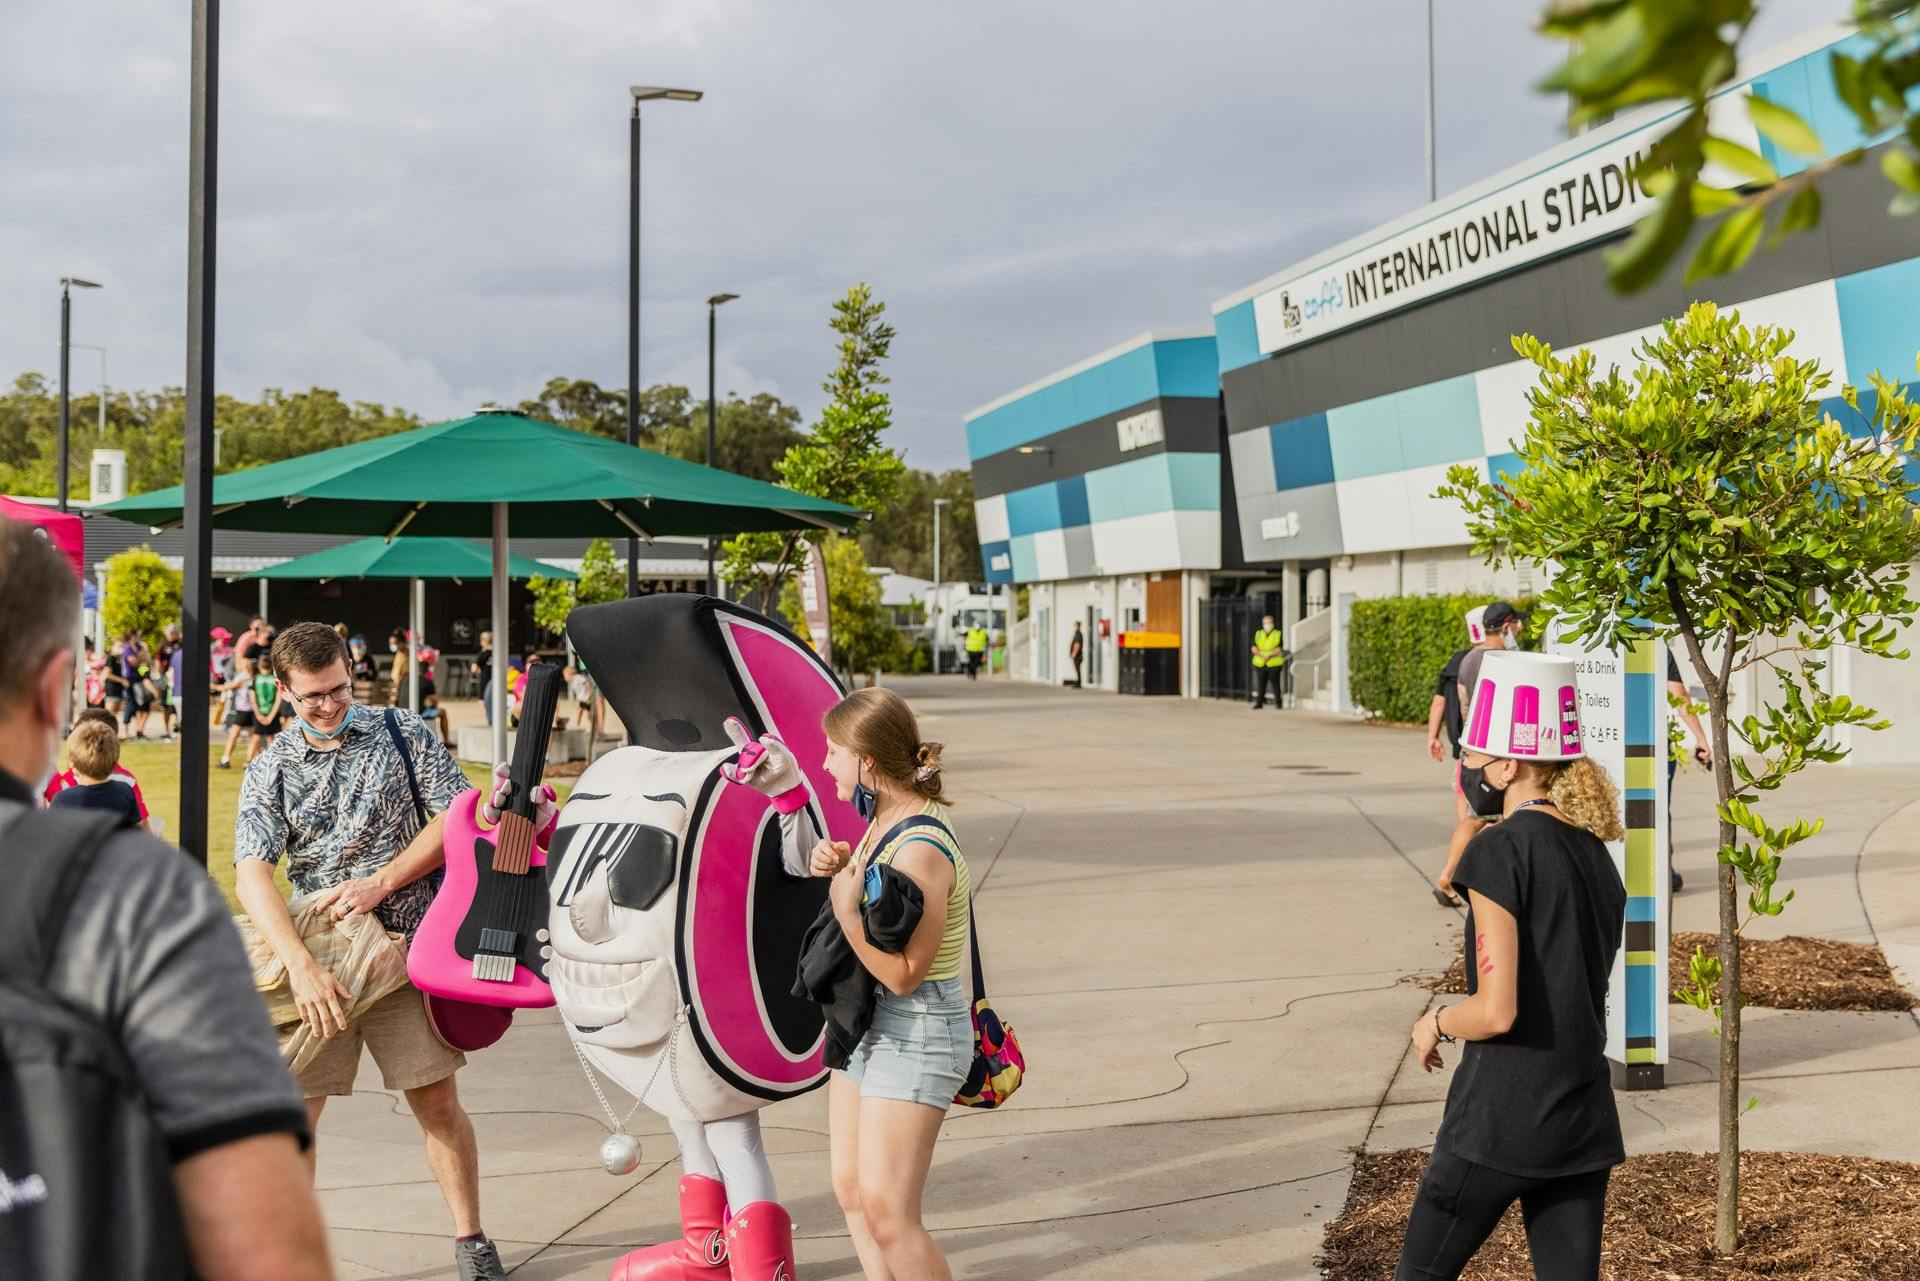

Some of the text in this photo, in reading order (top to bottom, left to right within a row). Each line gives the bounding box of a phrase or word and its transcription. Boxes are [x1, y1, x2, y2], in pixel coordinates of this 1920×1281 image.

[1346, 200, 1538, 309] INTERNATIONAL
[1544, 143, 1661, 234] STADI
[1576, 660, 1616, 674] od & Drink
[1585, 693, 1610, 708] Toilets
[1591, 727, 1618, 741] CAFE
